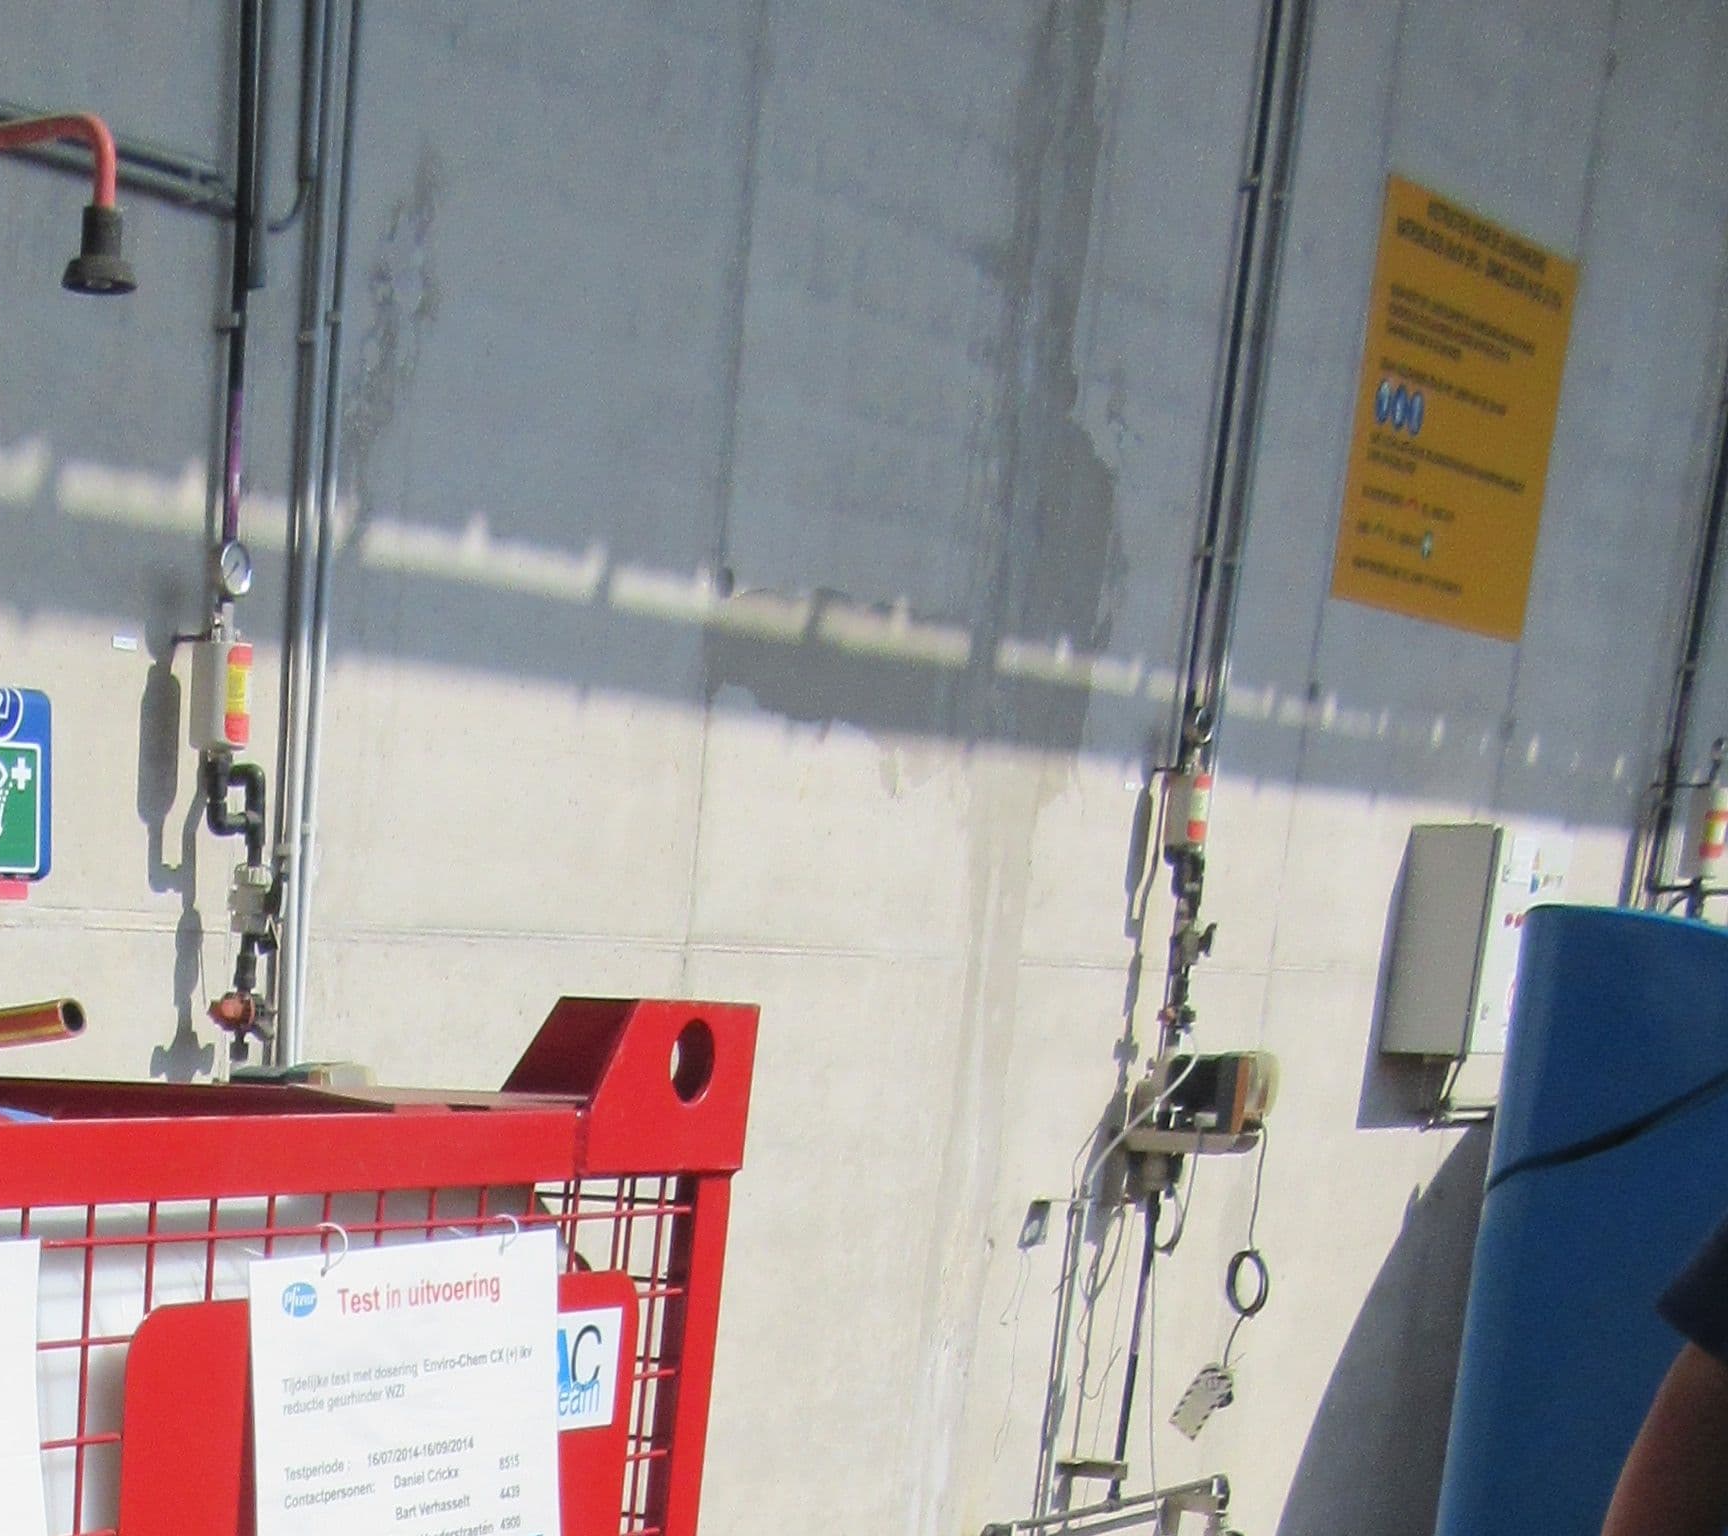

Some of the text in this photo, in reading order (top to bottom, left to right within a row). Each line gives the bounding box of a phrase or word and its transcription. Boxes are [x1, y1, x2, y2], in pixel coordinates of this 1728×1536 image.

[337, 1273, 501, 1316] Test in uitvoering
[331, 1370, 351, 1388] test
[353, 1367, 372, 1383] met
[374, 1360, 419, 1380] dosering
[423, 1353, 488, 1373] Enviro-Chem
[490, 1347, 505, 1364] CX
[284, 1458, 345, 1482] Testperiode
[367, 1437, 474, 1468] 16/07/2014-16/09/2014
[284, 1482, 376, 1510] Contactpersonen:
[393, 1472, 425, 1489] Daniel
[395, 1503, 417, 1521] Bart
